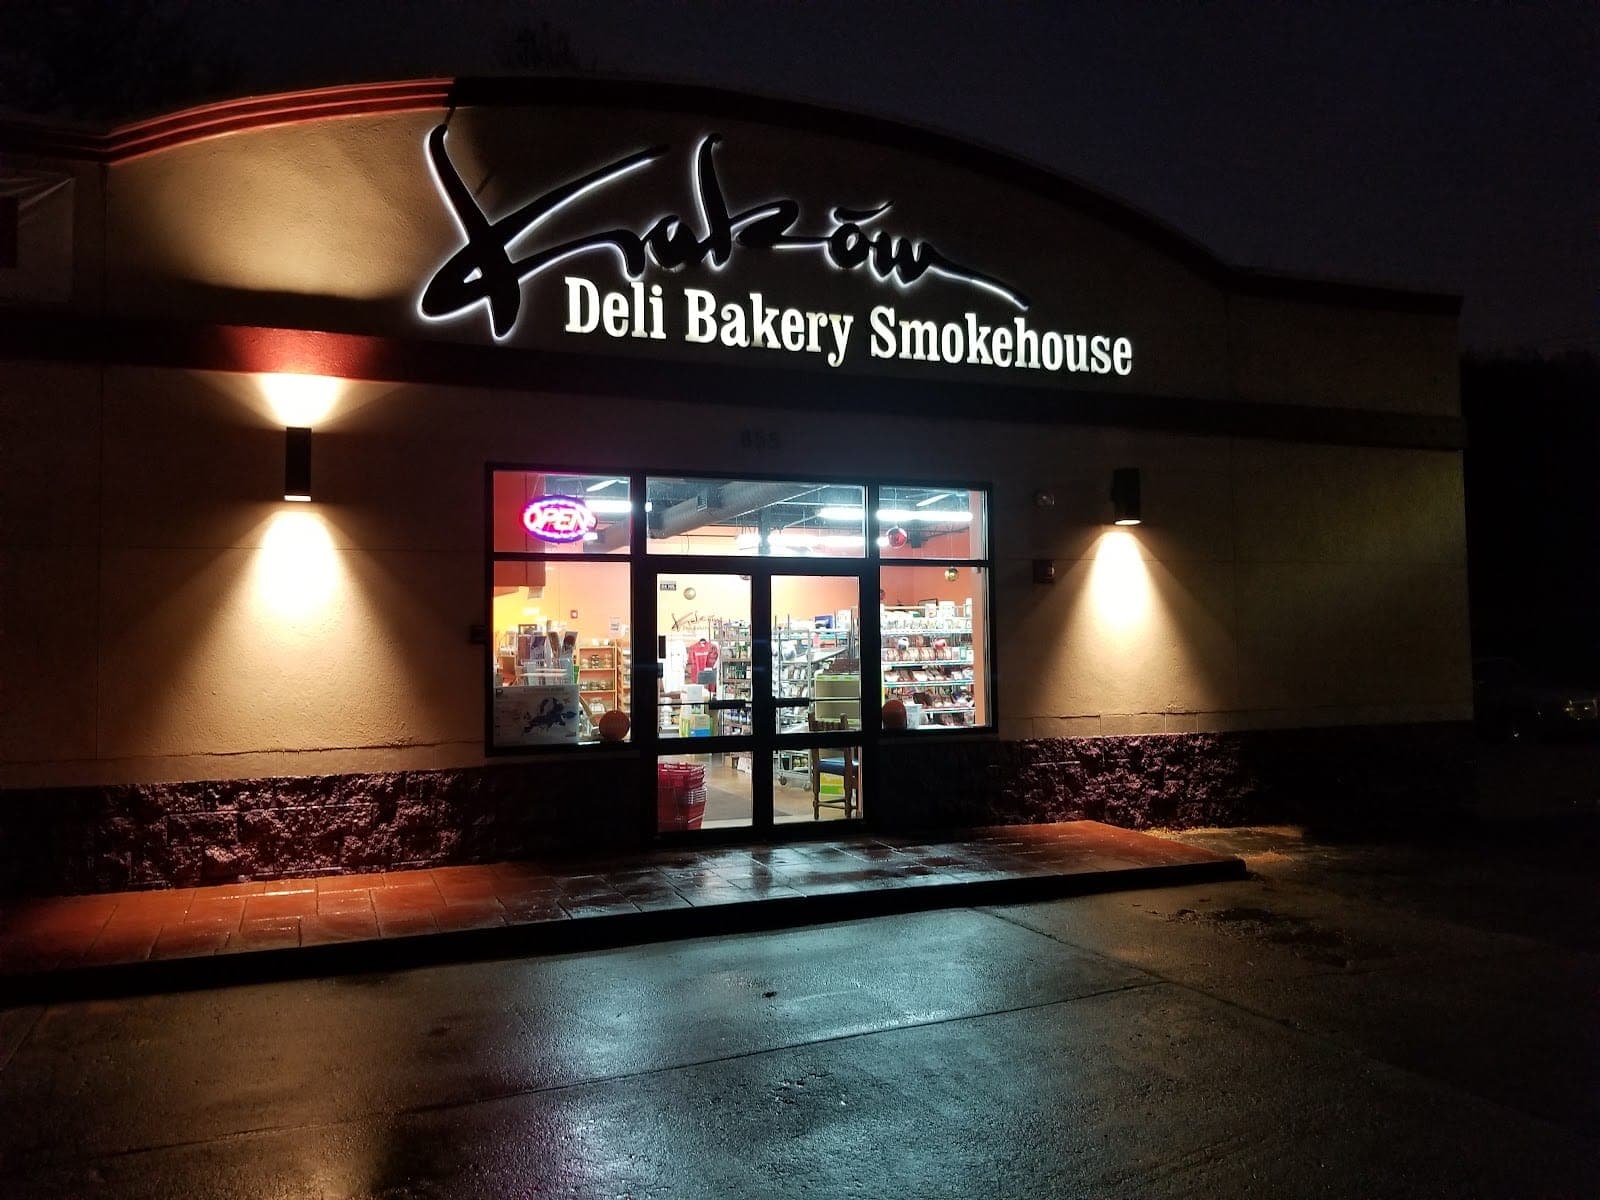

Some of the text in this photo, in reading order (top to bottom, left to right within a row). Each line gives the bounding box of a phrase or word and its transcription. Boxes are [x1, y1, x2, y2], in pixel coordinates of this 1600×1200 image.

[564, 276, 1133, 377] Deli Bakery Smokehouse
[523, 506, 587, 532] OPEN
